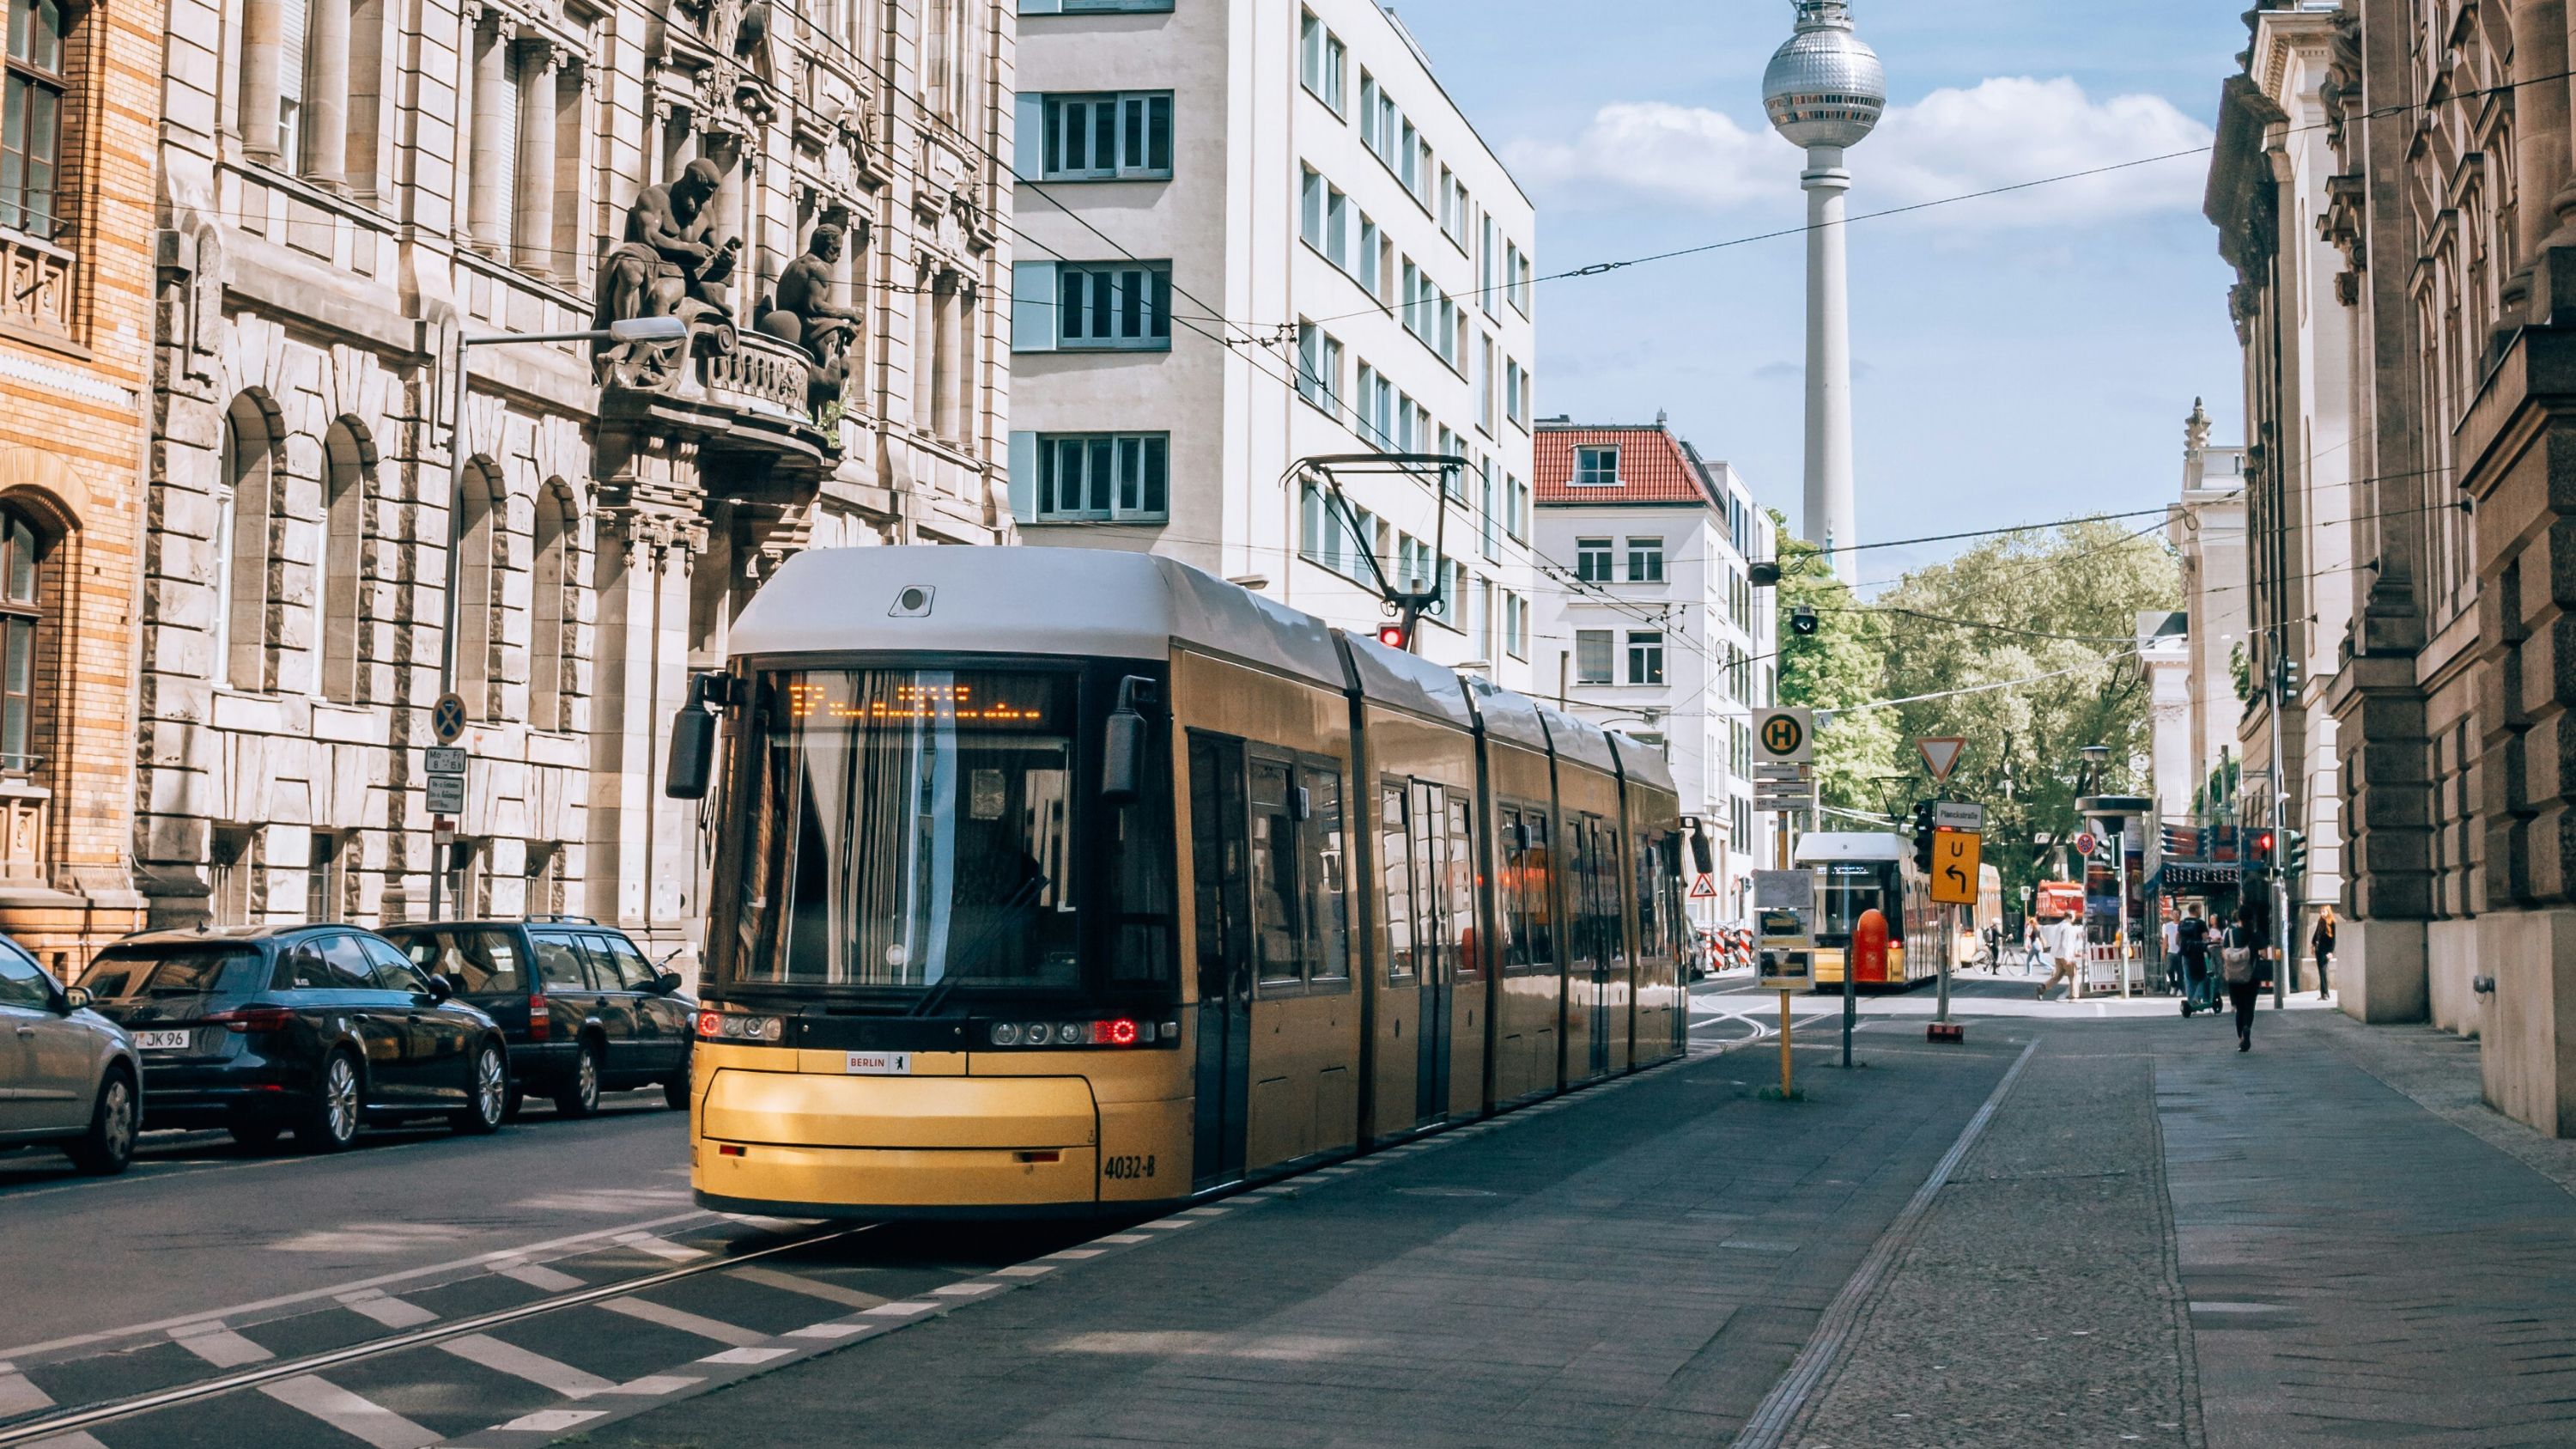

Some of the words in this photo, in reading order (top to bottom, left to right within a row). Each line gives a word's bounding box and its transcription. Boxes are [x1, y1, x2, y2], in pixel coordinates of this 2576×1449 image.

[1772, 724, 1790, 746] H
[429, 751, 441, 759] Mo
[453, 751, 462, 759] Fr
[1952, 842, 1963, 857] U
[147, 1032, 163, 1046] JK
[167, 1032, 184, 1045] 96
[851, 1058, 884, 1067] BERLIN
